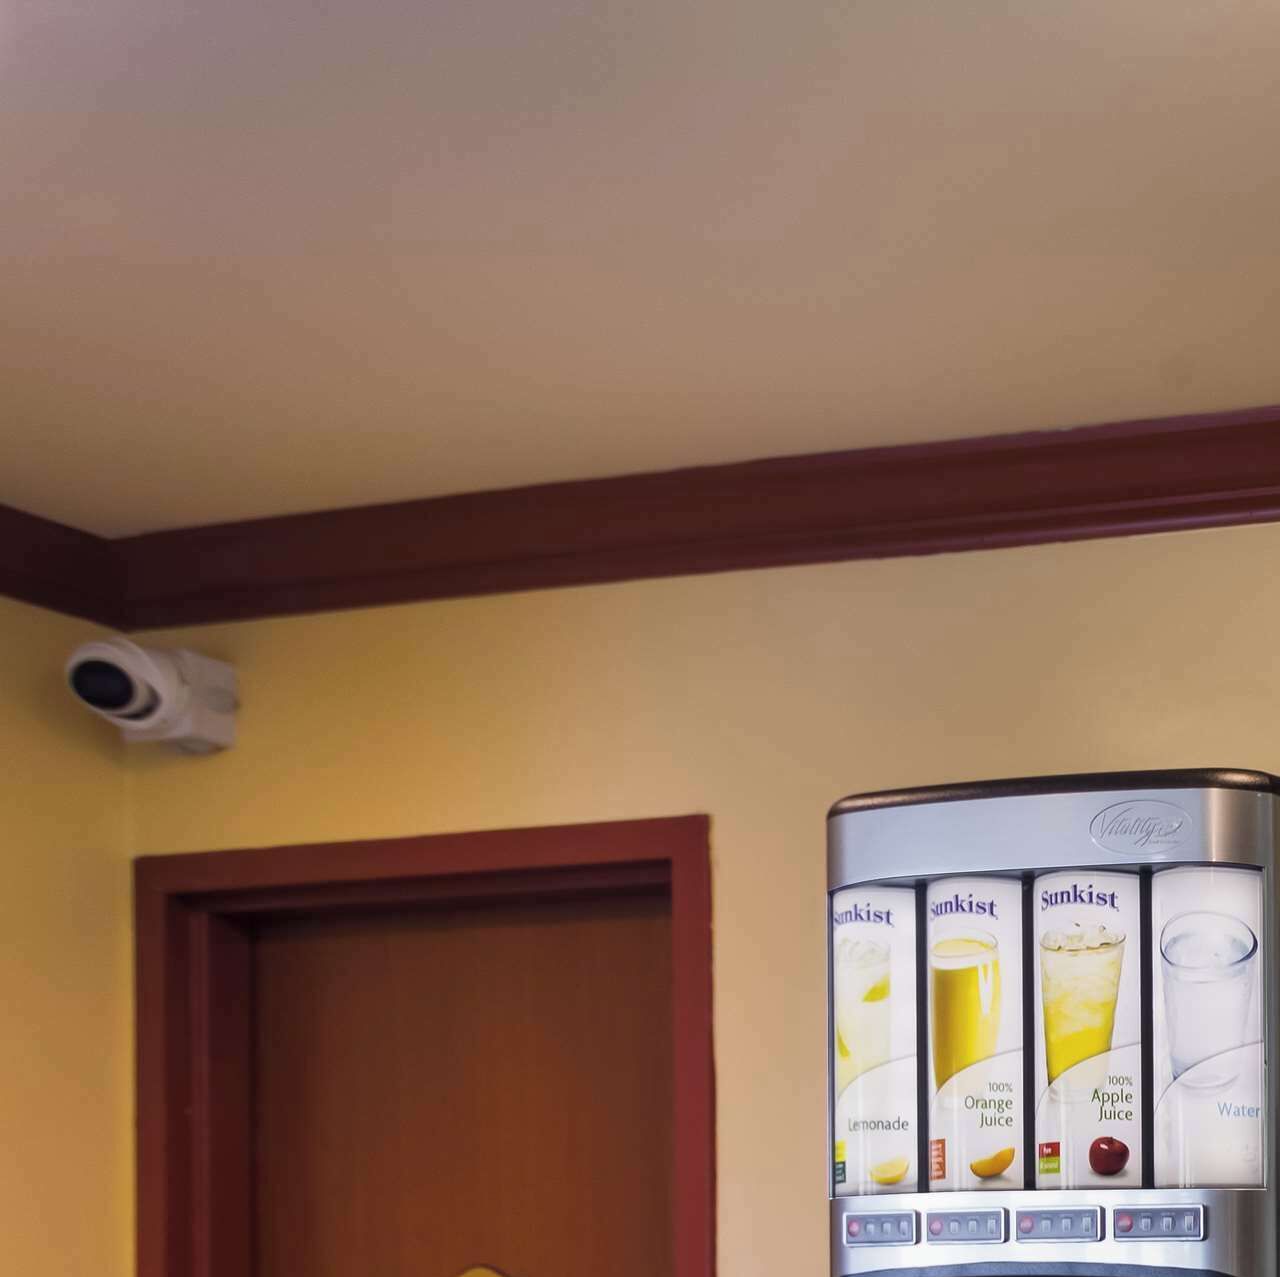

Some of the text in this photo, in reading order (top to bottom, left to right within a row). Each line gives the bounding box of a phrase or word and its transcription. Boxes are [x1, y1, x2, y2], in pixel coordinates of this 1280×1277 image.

[1040, 884, 1119, 912] Sunkist
[930, 893, 999, 920] Sunkist
[988, 1082, 1013, 1093] 100%
[1108, 1075, 1133, 1087] 100%
[964, 1096, 1013, 1114] Orange
[1091, 1088, 1133, 1108] Apple
[1098, 1106, 1133, 1121] Juice
[1217, 1102, 1260, 1118] Water
[848, 1116, 909, 1132] Lemonade
[979, 1113, 1013, 1128] Juice
